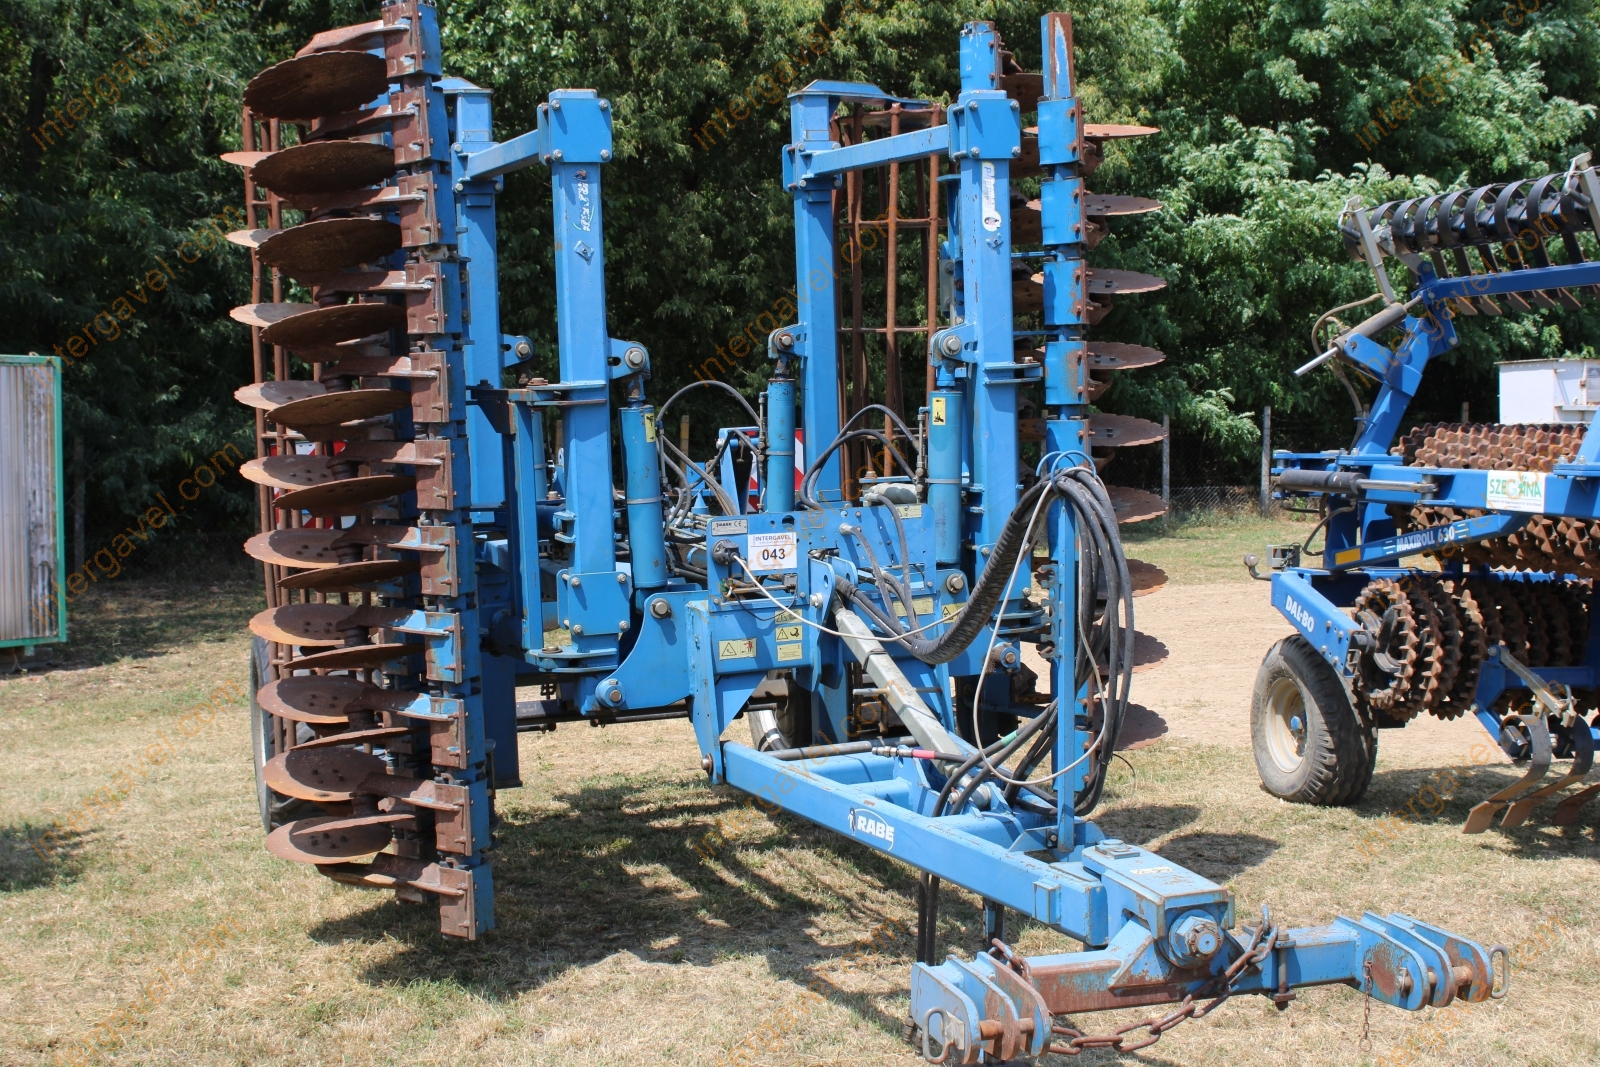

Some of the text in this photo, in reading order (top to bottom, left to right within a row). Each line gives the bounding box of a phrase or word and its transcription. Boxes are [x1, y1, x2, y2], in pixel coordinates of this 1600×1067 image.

[755, 534, 791, 542] INTERGAVEL
[1396, 526, 1455, 552] MAXIROLL 630
[762, 548, 785, 561] 043
[857, 815, 895, 842] RABE
